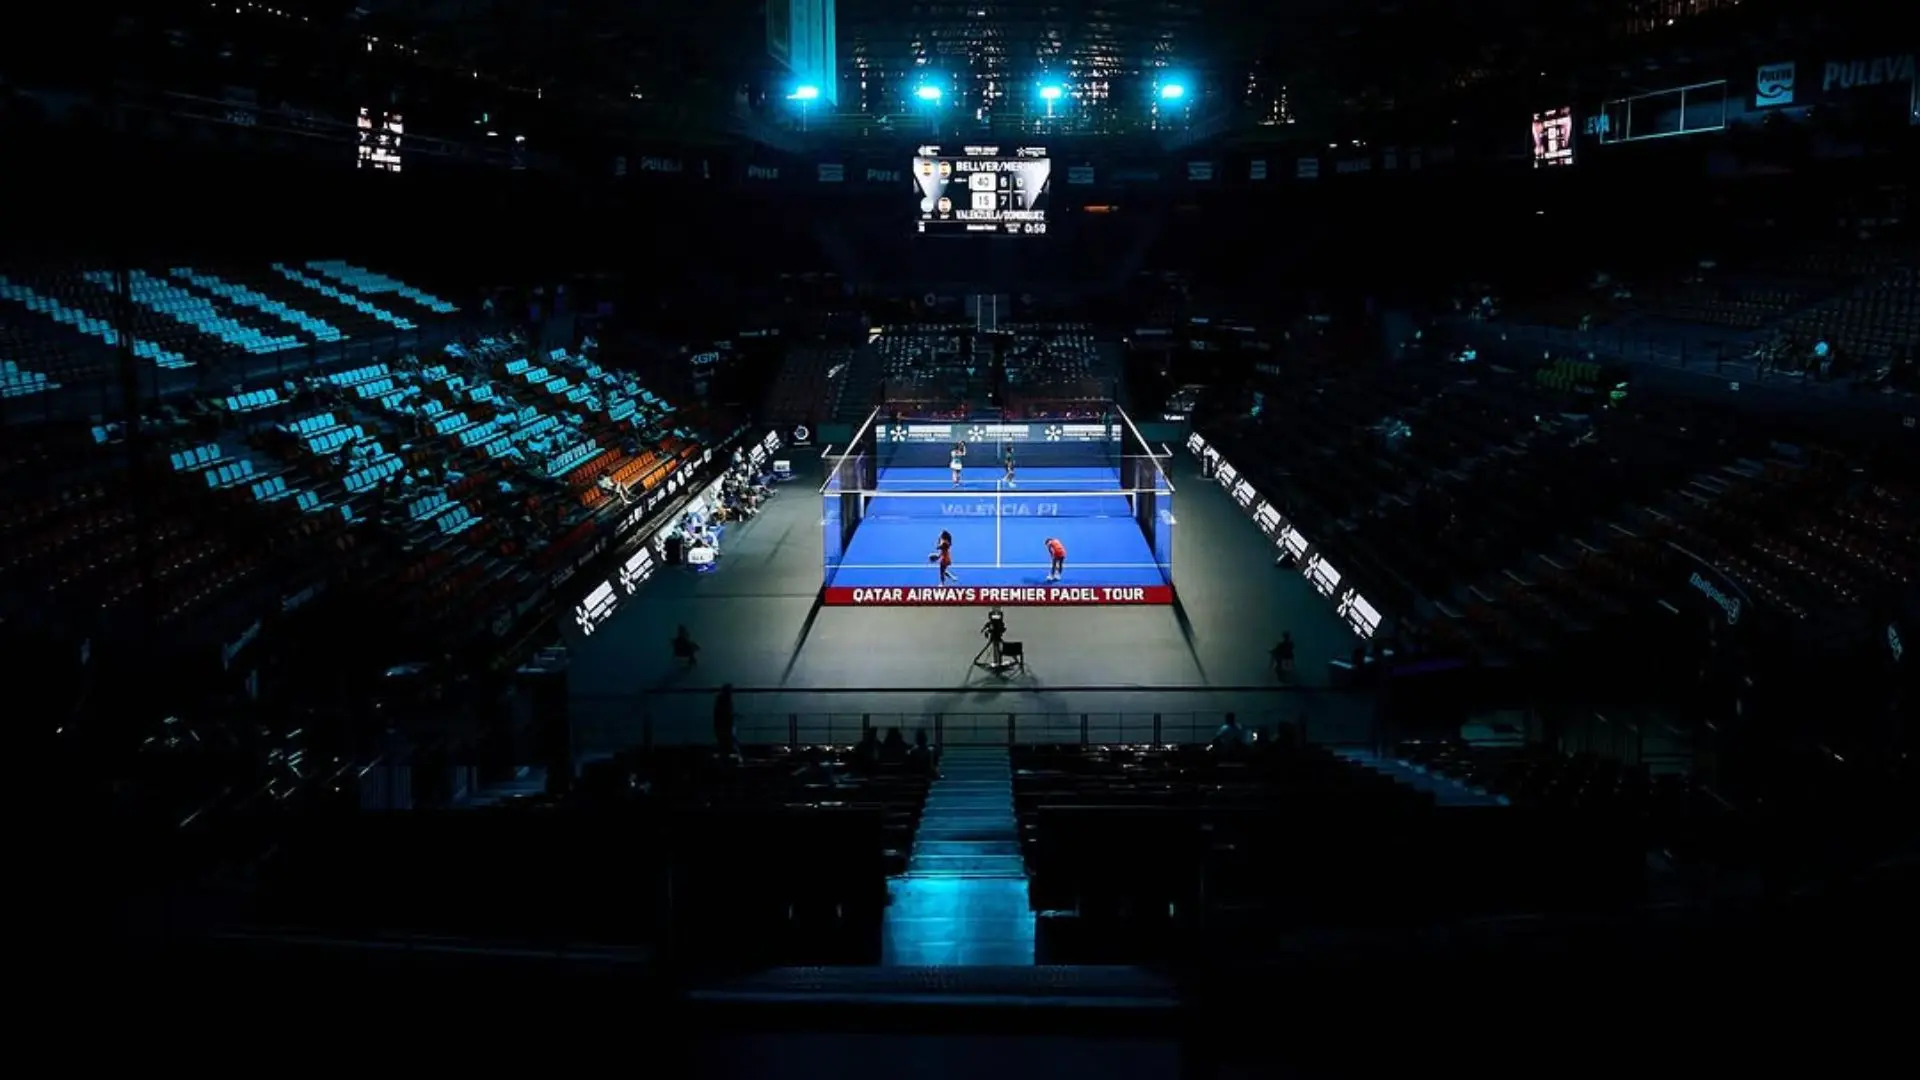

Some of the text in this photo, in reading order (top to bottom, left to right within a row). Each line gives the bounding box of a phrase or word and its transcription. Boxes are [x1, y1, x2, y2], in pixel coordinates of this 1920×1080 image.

[1821, 51, 1914, 91] PULEVA
[941, 502, 1029, 517] VALENCIA
[853, 588, 1144, 602] QATAR AIRWAYS PREMIER PADEL TOUR
